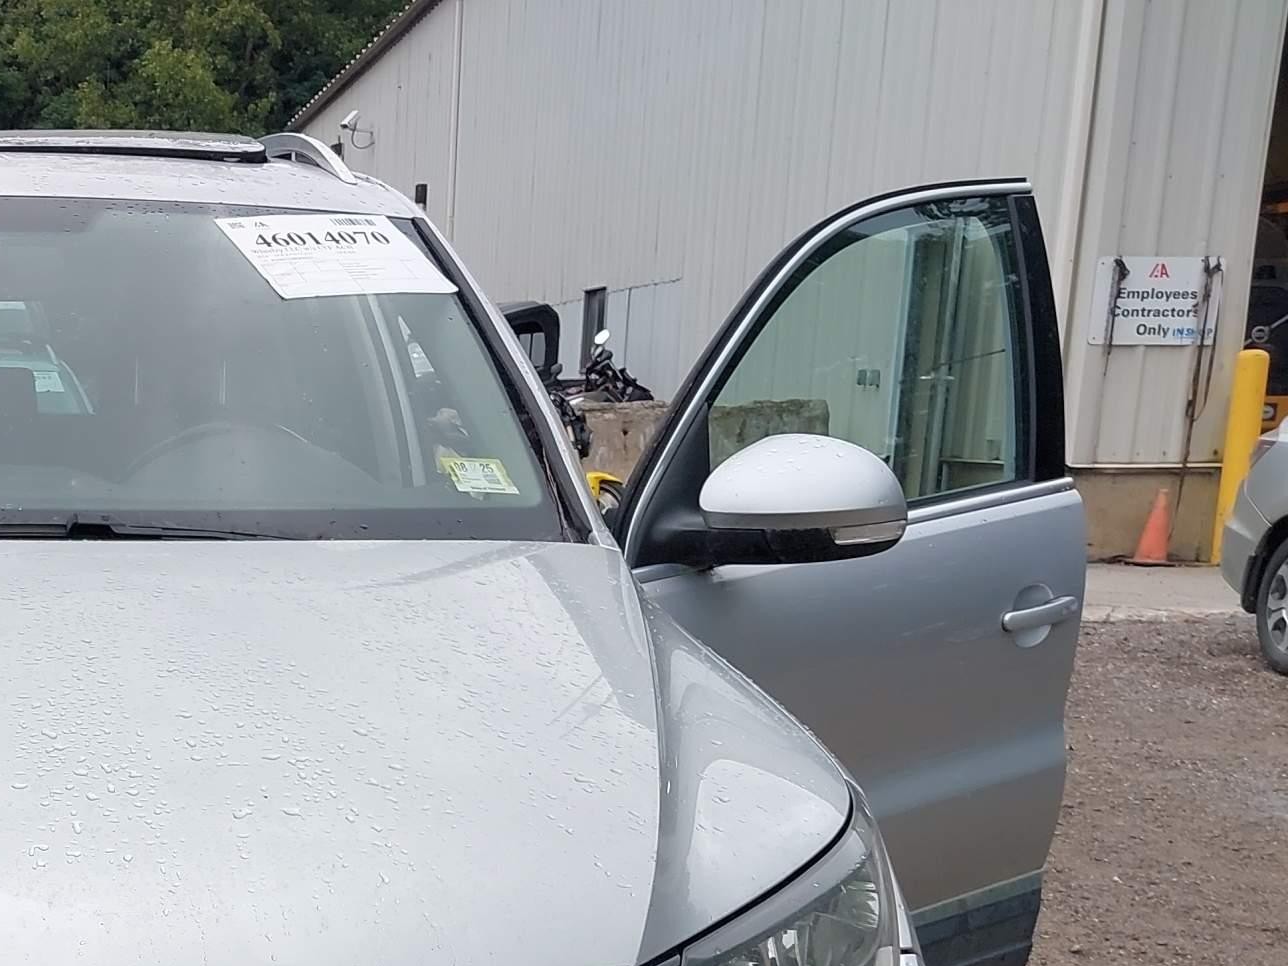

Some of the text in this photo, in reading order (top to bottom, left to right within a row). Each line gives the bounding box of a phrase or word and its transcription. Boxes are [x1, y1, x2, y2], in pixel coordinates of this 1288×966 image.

[254, 230, 391, 248] 46014070
[1117, 287, 1199, 302] Employees
[1136, 323, 1170, 338] Only
[479, 463, 494, 473] 25
